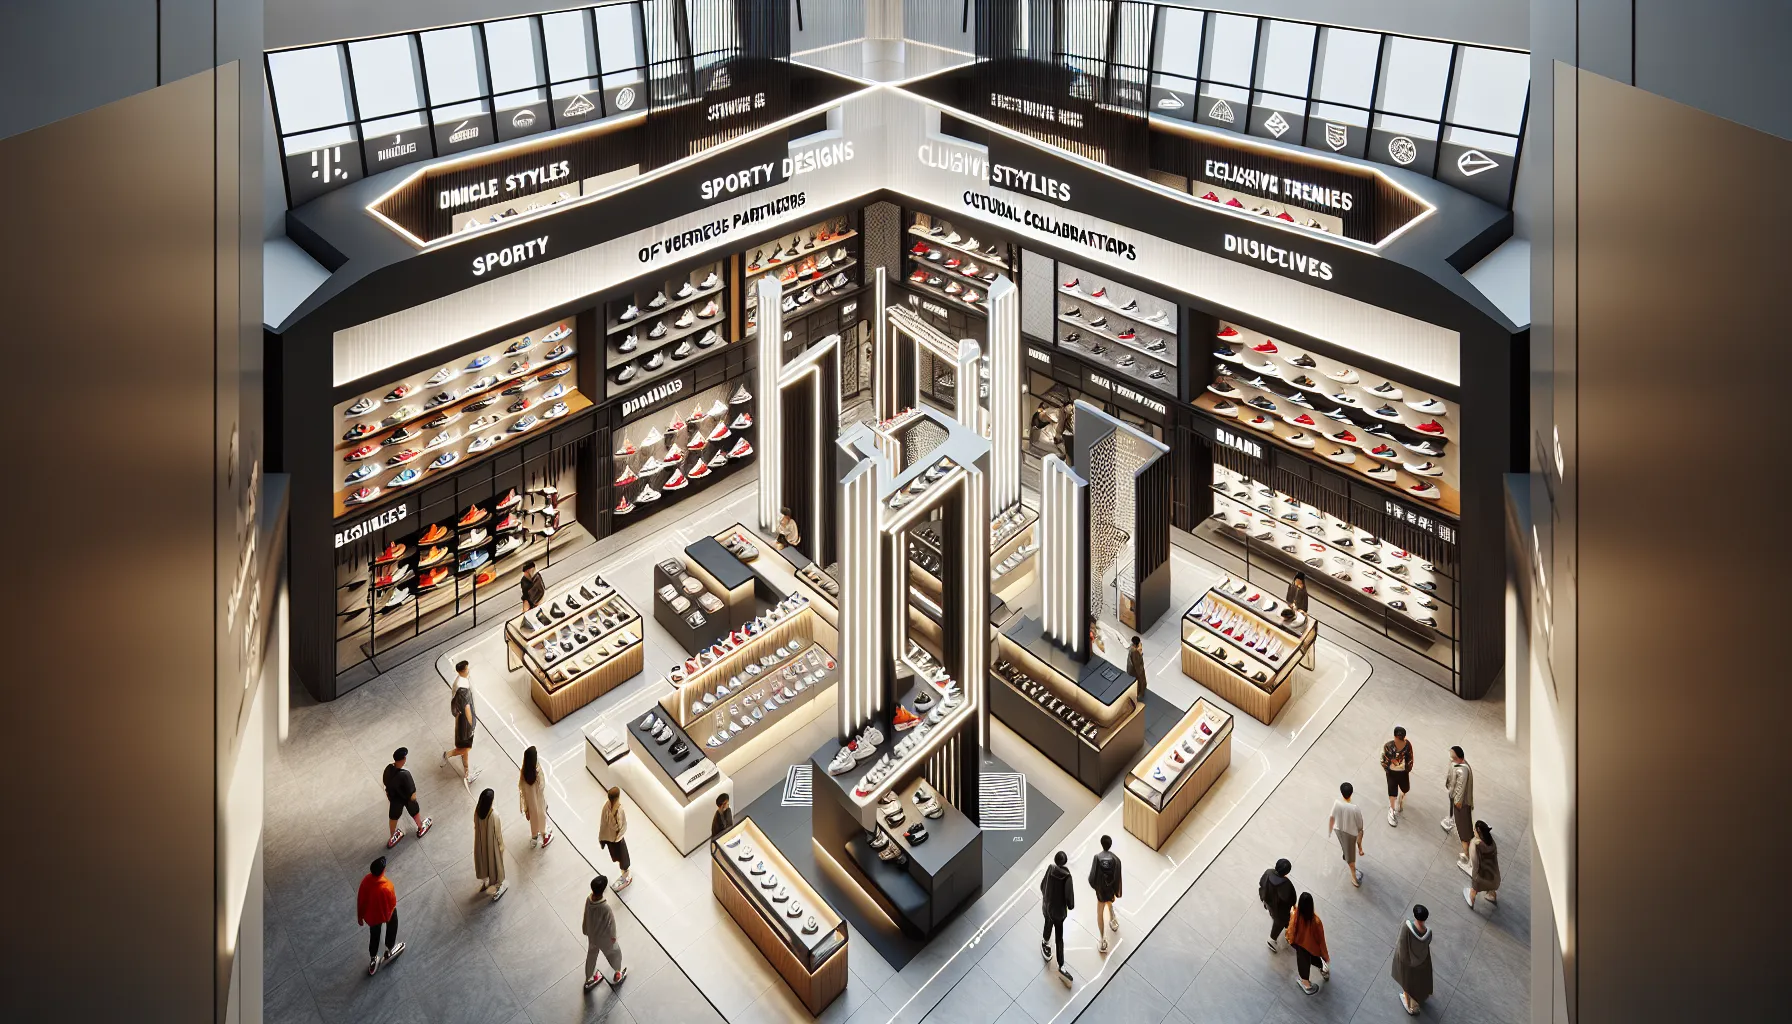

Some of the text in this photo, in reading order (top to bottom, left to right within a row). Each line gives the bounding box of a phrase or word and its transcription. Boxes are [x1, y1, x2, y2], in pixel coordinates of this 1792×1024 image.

[505, 160, 570, 192] STYLES
[701, 141, 854, 200] SPORTY DESIGNS
[472, 235, 549, 276] SPORTY
[638, 241, 662, 263] OF
